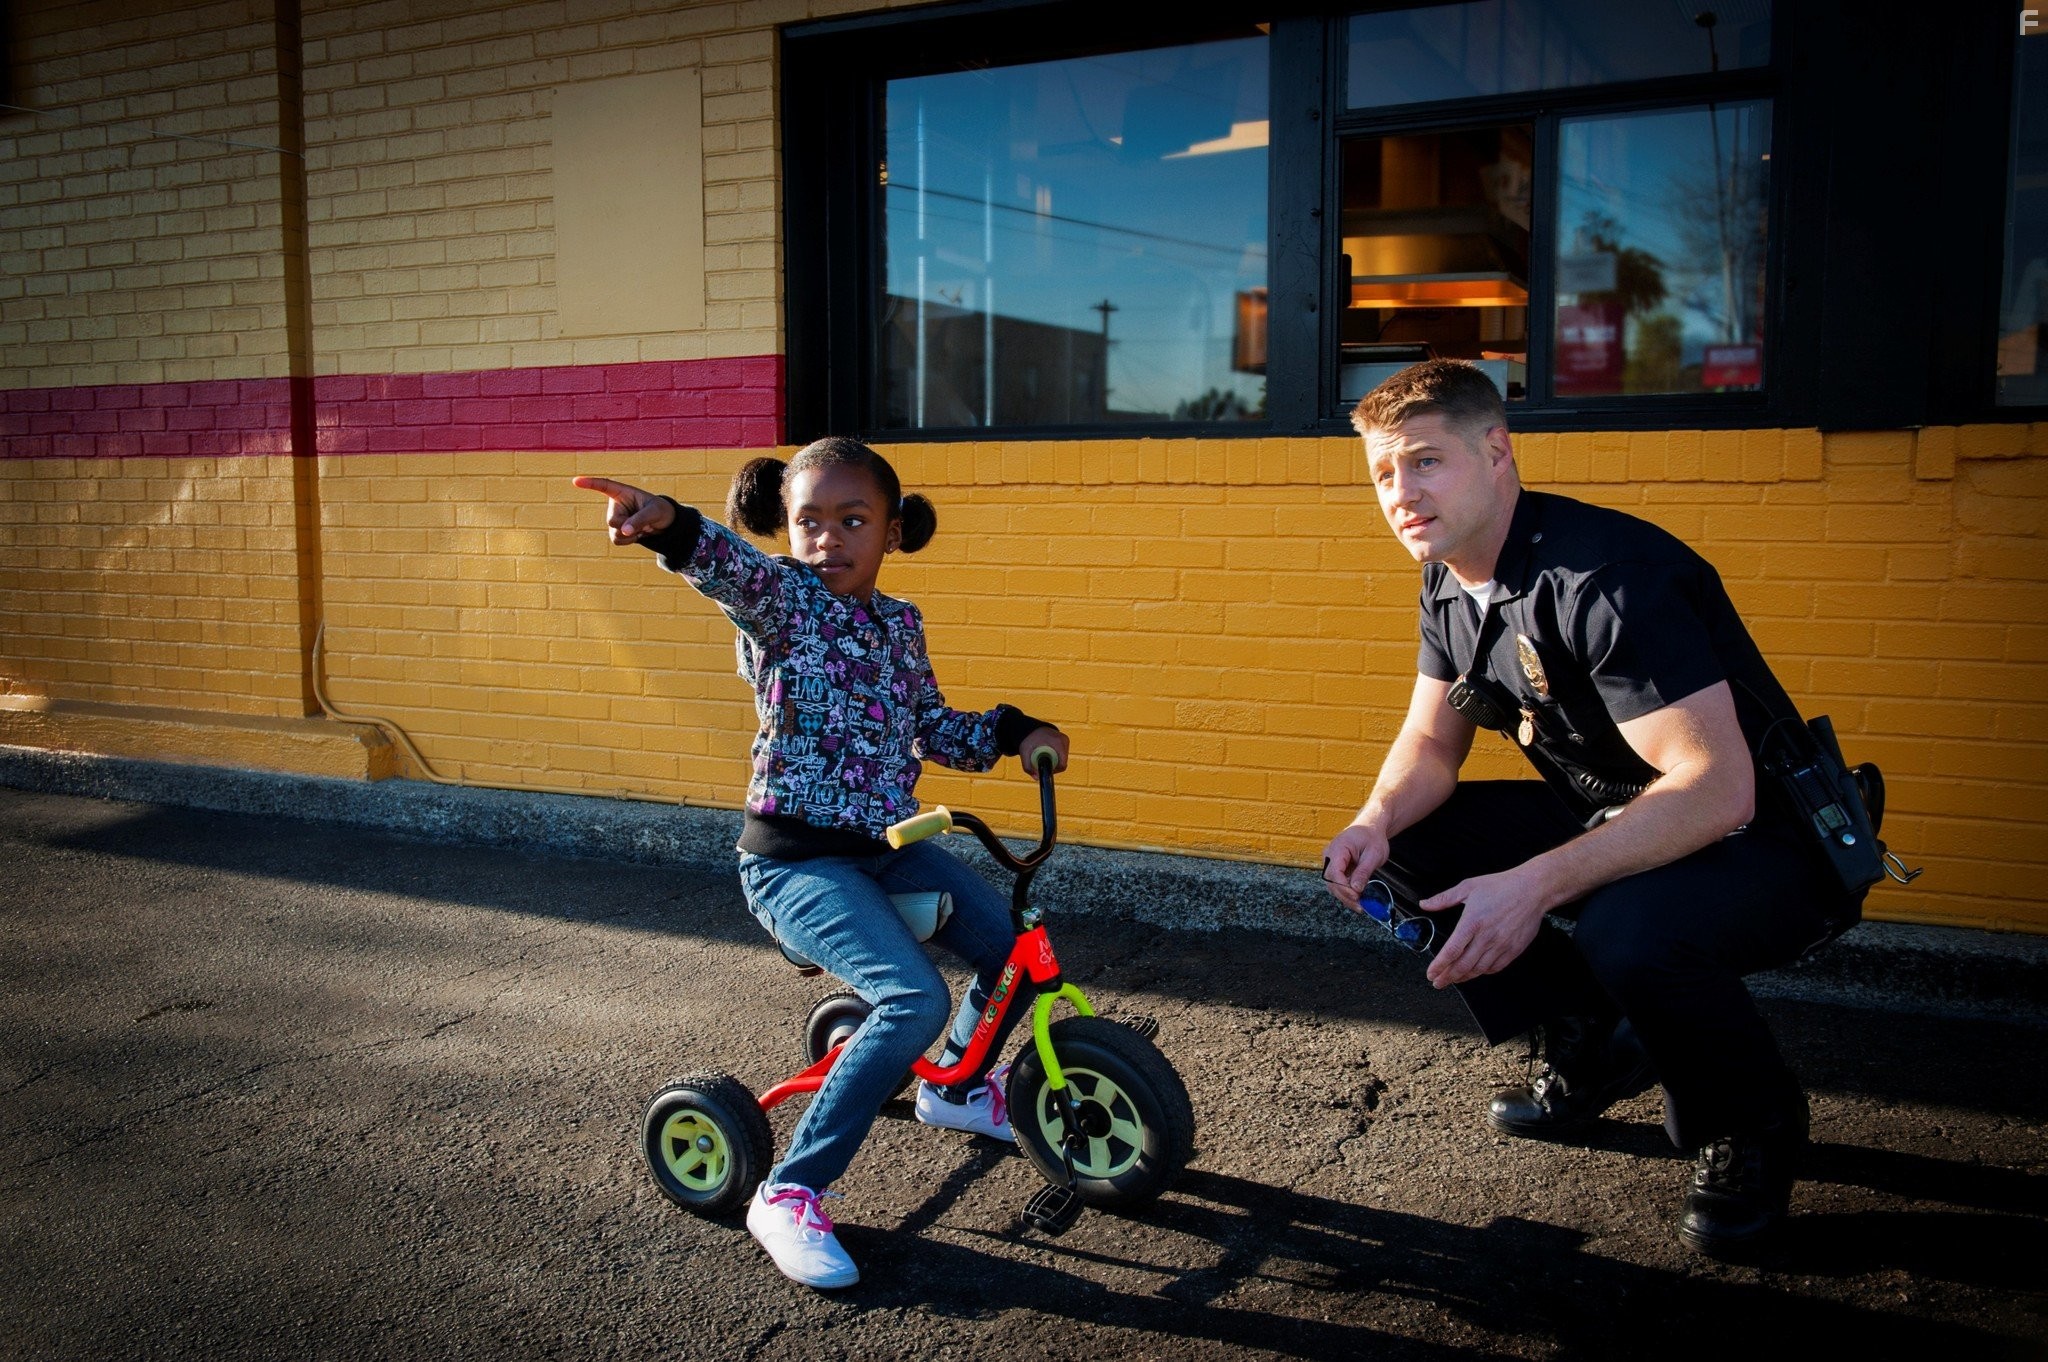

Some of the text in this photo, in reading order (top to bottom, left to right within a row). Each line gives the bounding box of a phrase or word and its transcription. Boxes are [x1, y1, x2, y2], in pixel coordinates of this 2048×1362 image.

[782, 734, 819, 756] LOVE
[976, 962, 1018, 1040] Nice Cycle
